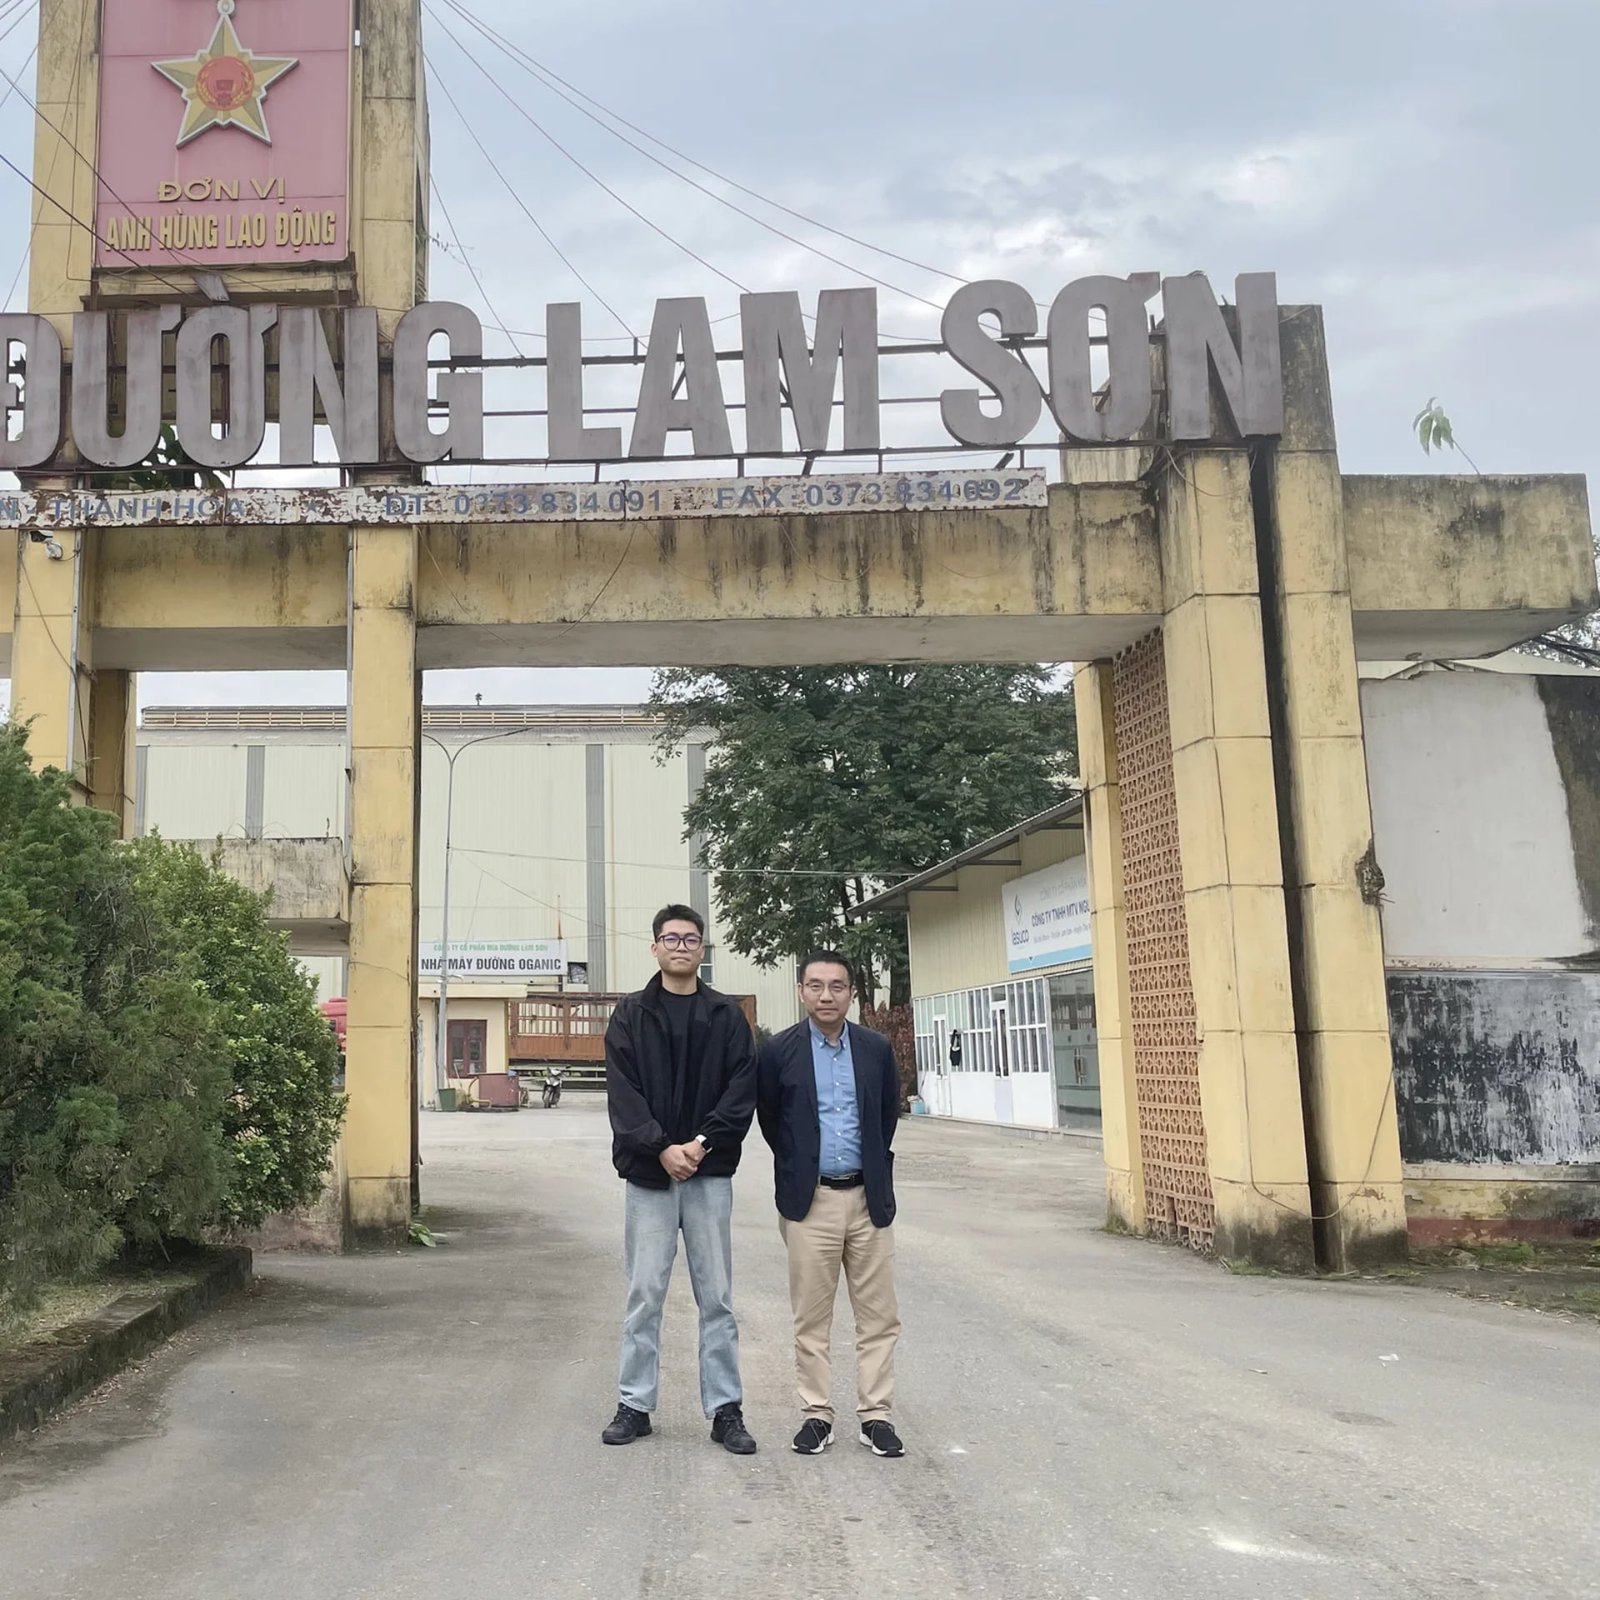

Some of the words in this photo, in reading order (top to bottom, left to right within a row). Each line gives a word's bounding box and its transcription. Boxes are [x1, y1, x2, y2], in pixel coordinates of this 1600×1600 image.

[157, 176, 240, 203] ĐƠN
[250, 177, 286, 205] VỊ
[105, 215, 153, 252] ANH
[159, 208, 218, 250] HÙNG
[224, 212, 267, 249] LAO
[275, 204, 337, 253] ĐỘNG
[545, 287, 881, 460] LAM
[940, 271, 1284, 447] SƠN
[50, 496, 163, 521] THANH
[540, 489, 600, 514] 834
[608, 488, 662, 513] 091
[805, 481, 882, 507] 0373
[518, 958, 561, 970] OGANIC
